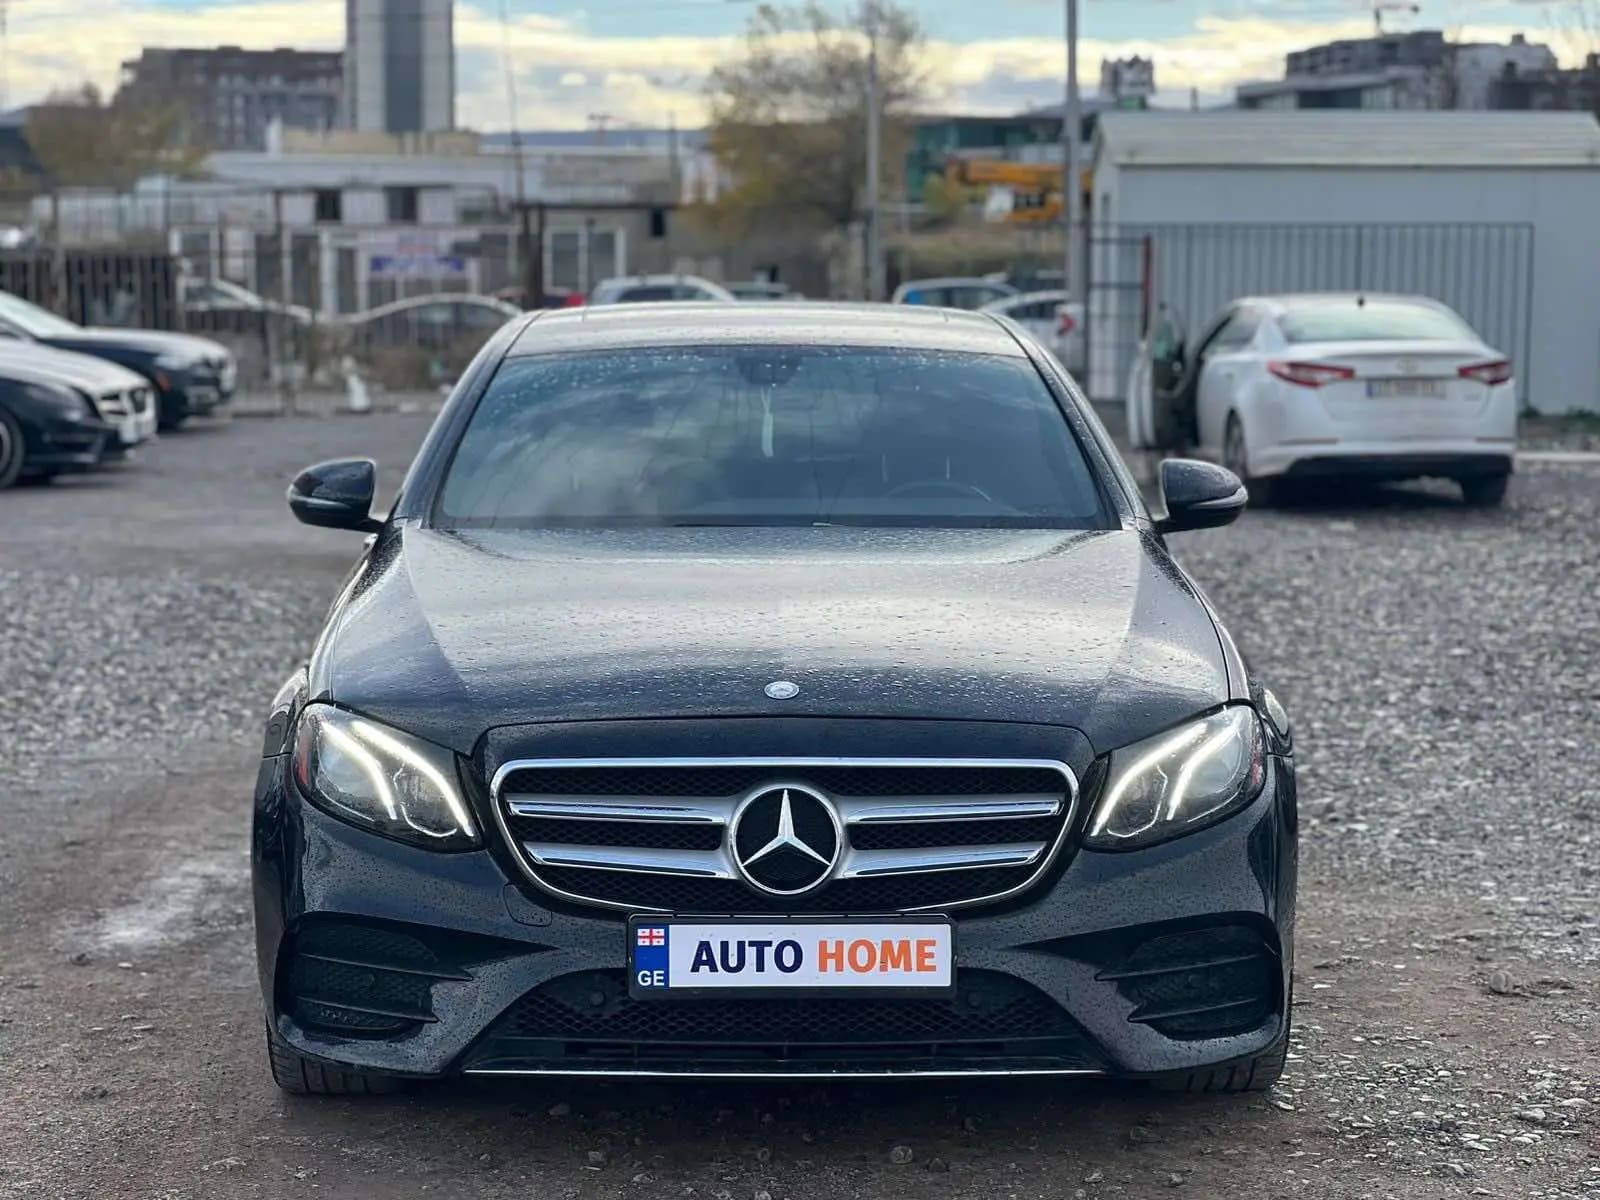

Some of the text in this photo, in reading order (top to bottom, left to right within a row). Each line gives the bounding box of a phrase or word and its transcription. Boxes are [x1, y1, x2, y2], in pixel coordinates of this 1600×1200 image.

[690, 939, 937, 973] AUTO HOME
[637, 970, 665, 986] GE
